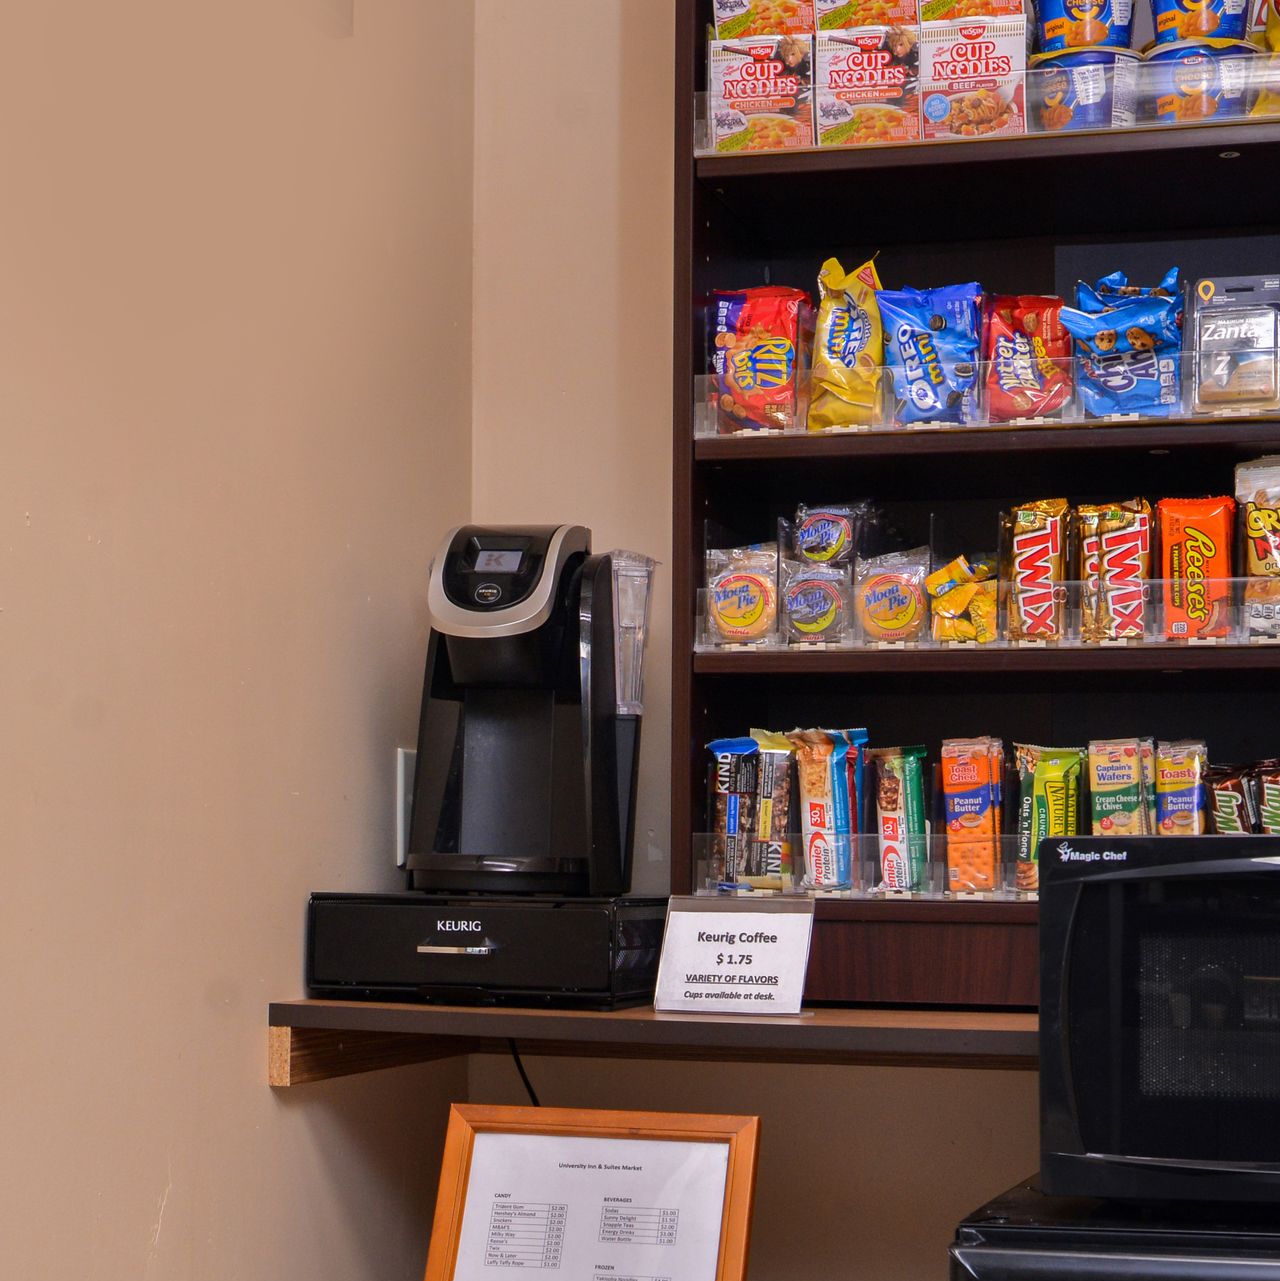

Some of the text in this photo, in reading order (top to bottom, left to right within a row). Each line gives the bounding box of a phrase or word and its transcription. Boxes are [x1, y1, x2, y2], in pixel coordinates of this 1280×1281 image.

[857, 36, 880, 46] NISSIN
[749, 47, 773, 56] NISSIN
[846, 50, 891, 70] CUP
[950, 42, 996, 61] CUP
[739, 62, 783, 80] CUP
[829, 67, 905, 89] NOODLES
[932, 56, 1011, 81] NOODLES
[723, 77, 797, 99] NOODLES
[832, 306, 850, 360] mini
[754, 337, 796, 389] RITZ
[897, 323, 943, 412] OREO
[915, 333, 946, 386] mini
[996, 335, 1015, 392] Nutter
[1214, 355, 1231, 376] Z
[732, 351, 755, 391] bits
[799, 520, 834, 543] Moon
[820, 529, 839, 547] Pie
[1012, 516, 1062, 635] TWIX
[1183, 525, 1217, 624] Reese's
[714, 584, 750, 604] Moon
[736, 591, 757, 610] Pie
[864, 584, 900, 605] Moon
[887, 593, 908, 611] Pie
[718, 752, 732, 794] KIND
[950, 765, 976, 774] Toast
[950, 773, 977, 782] Chee
[1096, 764, 1132, 774] Captain's
[1097, 772, 1132, 782] Wafers
[1159, 768, 1198, 780] Toasty
[954, 804, 980, 812] Butter
[1049, 784, 1066, 833] NATURE
[1095, 795, 1138, 804] Cream Cheese
[1095, 803, 1123, 811] & Chives
[1214, 790, 1243, 834] Way
[811, 844, 823, 885] Premier
[822, 847, 832, 881] Protein
[1071, 850, 1127, 862] Magic Chef
[437, 920, 482, 932] KEURIG
[697, 931, 778, 945] Keurig Coffee
[716, 953, 753, 966] $ 1.75
[685, 974, 779, 985] VARIETY OF FLAVORS
[684, 991, 776, 1001] Cups available at desk.
[558, 1162, 587, 1170] University
